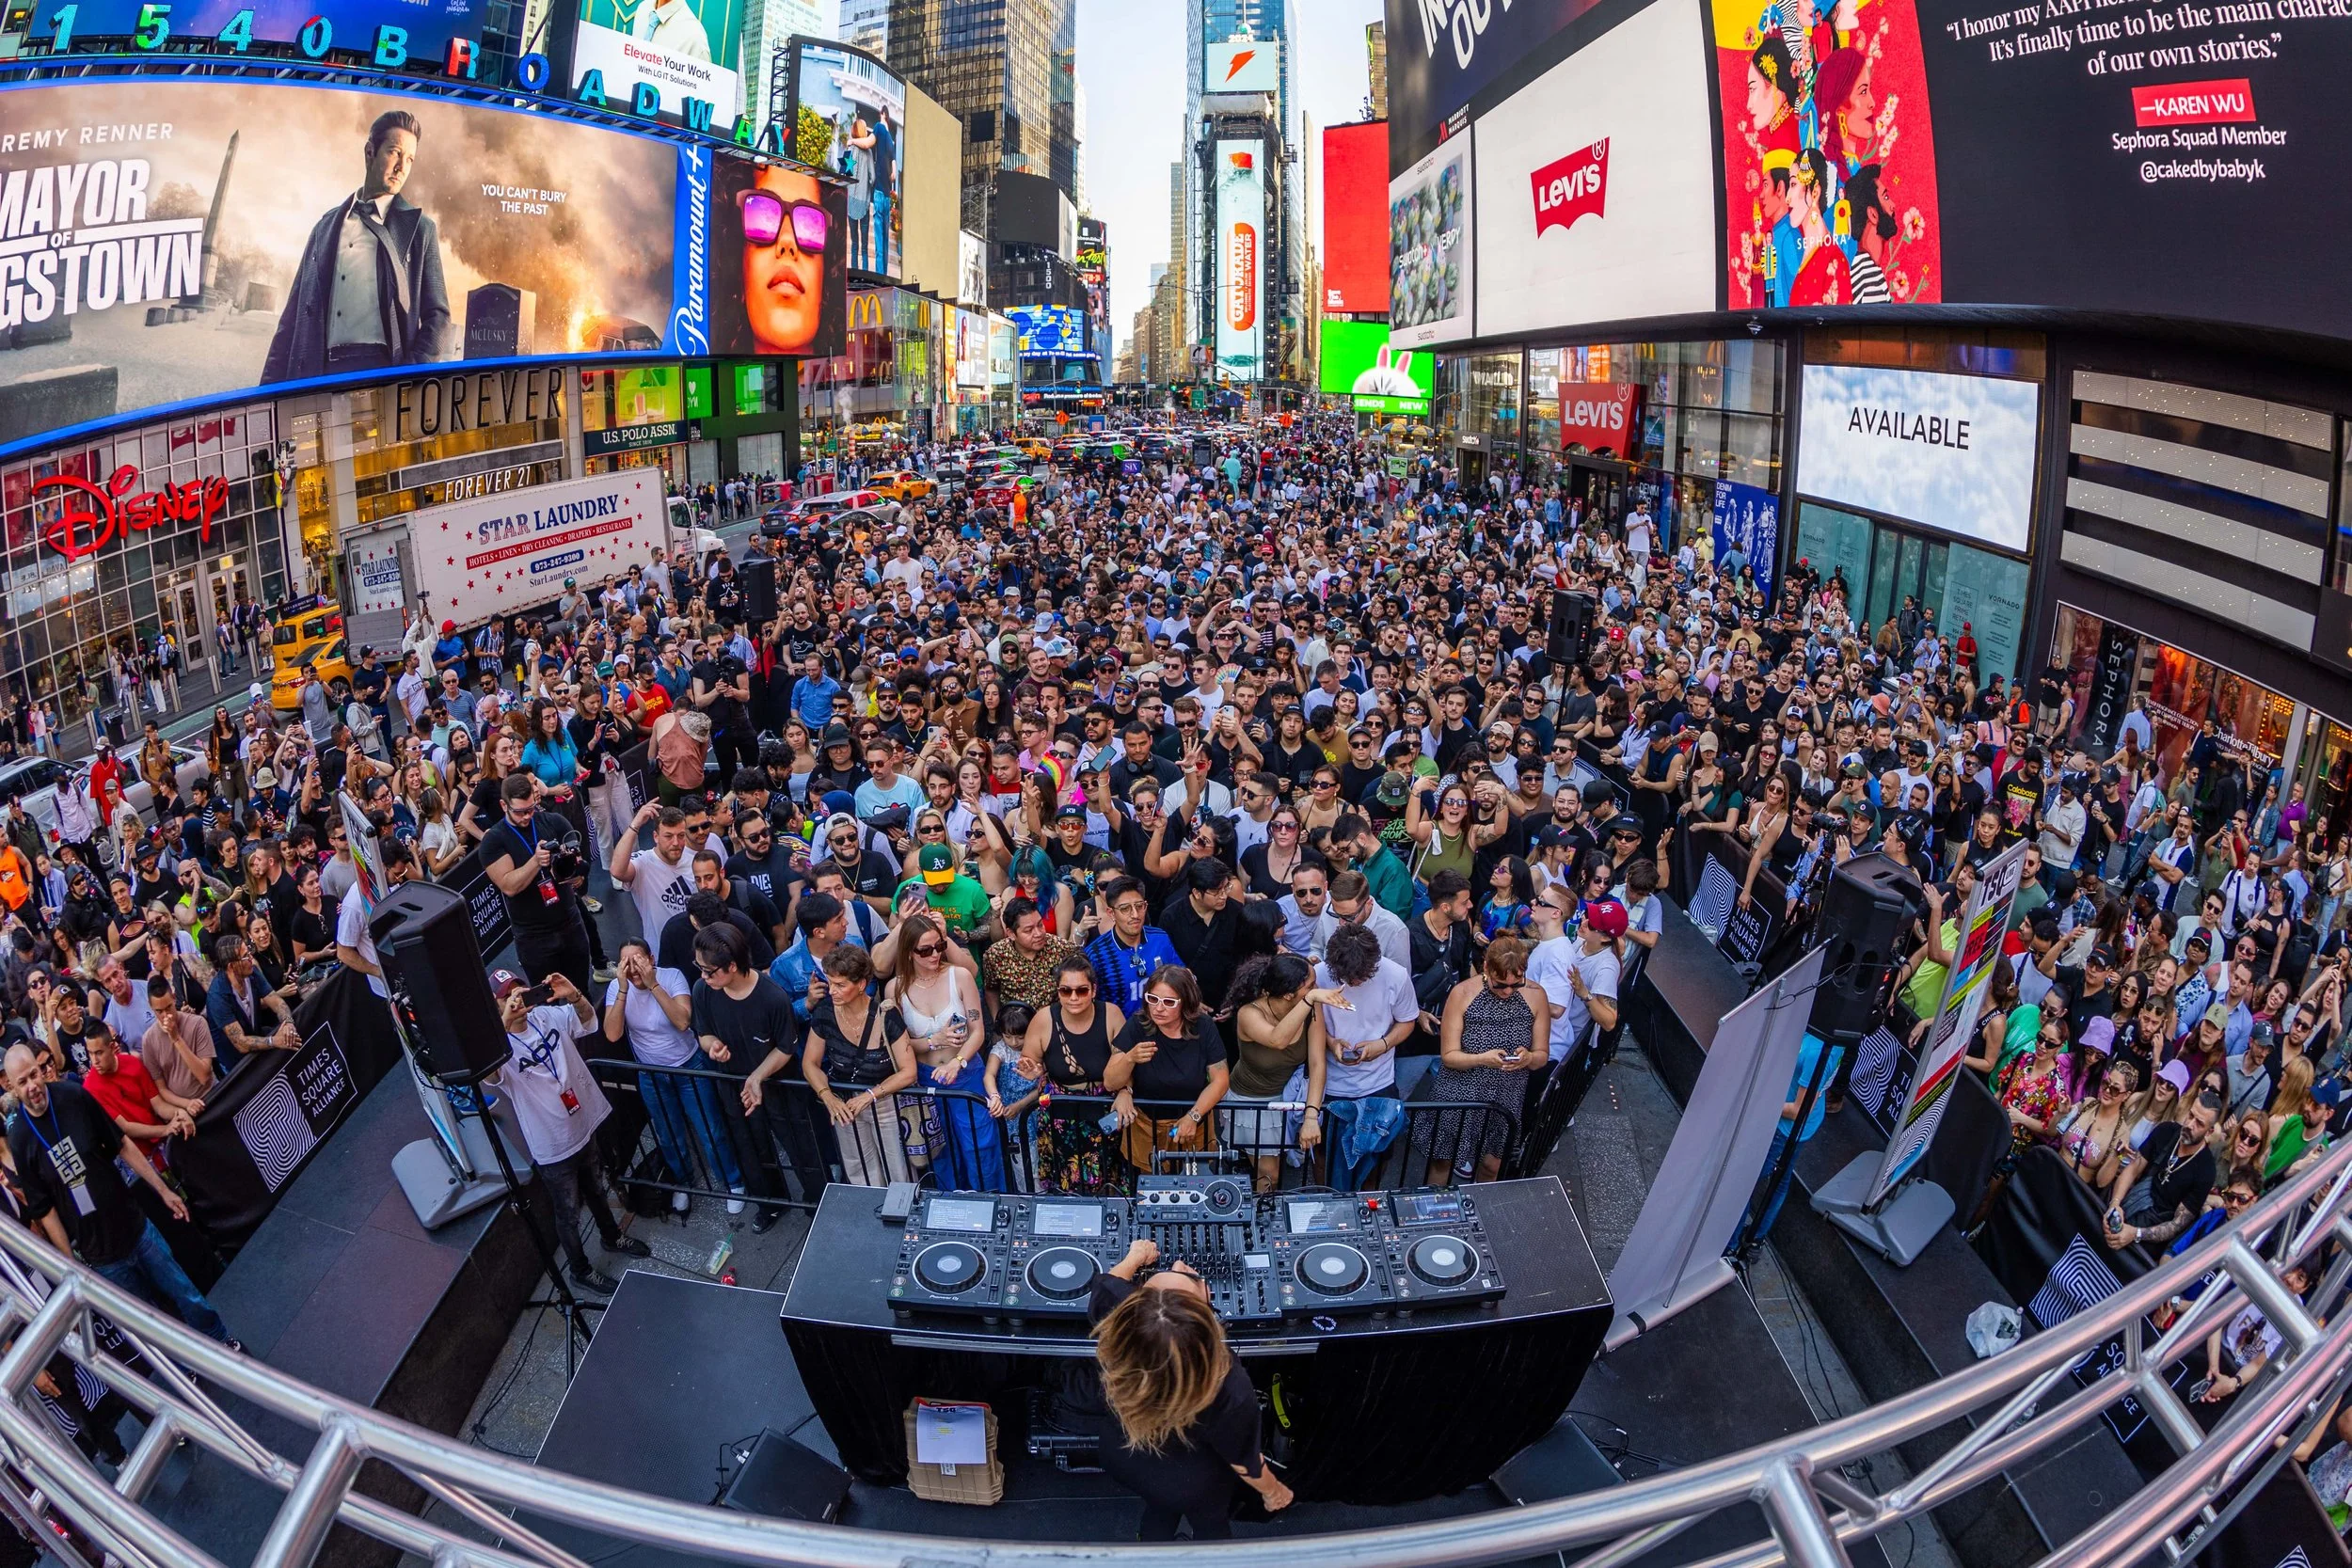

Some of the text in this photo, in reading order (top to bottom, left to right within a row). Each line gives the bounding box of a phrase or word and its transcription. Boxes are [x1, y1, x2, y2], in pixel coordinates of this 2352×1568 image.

[1963, 12, 2011, 38] honor
[2013, 7, 2042, 27] my
[2017, 25, 2073, 56] finally
[2076, 20, 2121, 45] time
[2123, 16, 2145, 36] to
[2148, 10, 2173, 33] be
[2175, 6, 2213, 29] the
[2215, 0, 2275, 24] main
[624, 43, 711, 82] Elevate Your Work
[2088, 49, 2108, 76] of
[2111, 50, 2145, 72] our
[2149, 46, 2195, 68] own
[48, 3, 790, 156] 1540 BROADWAY
[638, 65, 653, 75] With
[653, 70, 662, 79] LG
[670, 74, 697, 89] Solutions
[1448, 103, 1470, 124] MARRIOTT
[2210, 92, 2245, 114] WU
[79, 122, 173, 145] RENNER
[1448, 116, 1468, 135] MARQUIS
[2112, 126, 2287, 153] Sephora Squad Member
[2140, 158, 2266, 183] @cakedbybabyk
[0, 158, 151, 240] MAYOR
[481, 184, 566, 203] YOU CAN'T BURY
[501, 200, 549, 215] THE PAST
[50, 231, 72, 247] OF
[1245, 233, 1253, 270] WATER
[1437, 227, 1461, 253] VERDY
[1796, 234, 1847, 250] SEPHORA
[0, 232, 202, 330] GSTOWN
[1234, 233, 1246, 322] GATORADE
[395, 368, 562, 442] FOREVER
[602, 430, 620, 444] U.S.
[622, 427, 648, 442] POLO
[650, 423, 677, 439] ASSN.
[1848, 406, 1970, 451] AVAILABLE
[1124, 463, 1137, 471] SIX
[445, 466, 532, 502] FOREVER 21
[1715, 489, 1726, 500] FOR
[1716, 482, 1732, 492] DENIM
[1715, 499, 1725, 509] LIFE
[478, 494, 619, 546] STAR LAUNDRY
[469, 519, 631, 568] HOTELS LINEN DRY CLEANING DRAPERY RESTAURANTS
[1803, 533, 1825, 545] VORNADO
[533, 552, 580, 571] 973-247-9300
[529, 564, 588, 588] StarLaundry.com
[1753, 610, 1759, 620] 5
[1988, 594, 2020, 610] VORNADO
[2091, 640, 2122, 747] SEPHORA
[932, 857, 946, 871] A's
[470, 883, 496, 911] TIMES
[661, 894, 686, 906] adid
[472, 895, 501, 927] SQUARE
[479, 910, 503, 938] ALLIANCE
[1728, 931, 1753, 961] ALLIANCE
[1730, 915, 1759, 951] SQUARE
[296, 1048, 330, 1085] TIMES
[301, 1059, 342, 1105] SQUARE
[311, 1077, 346, 1117] ALLIANCE
